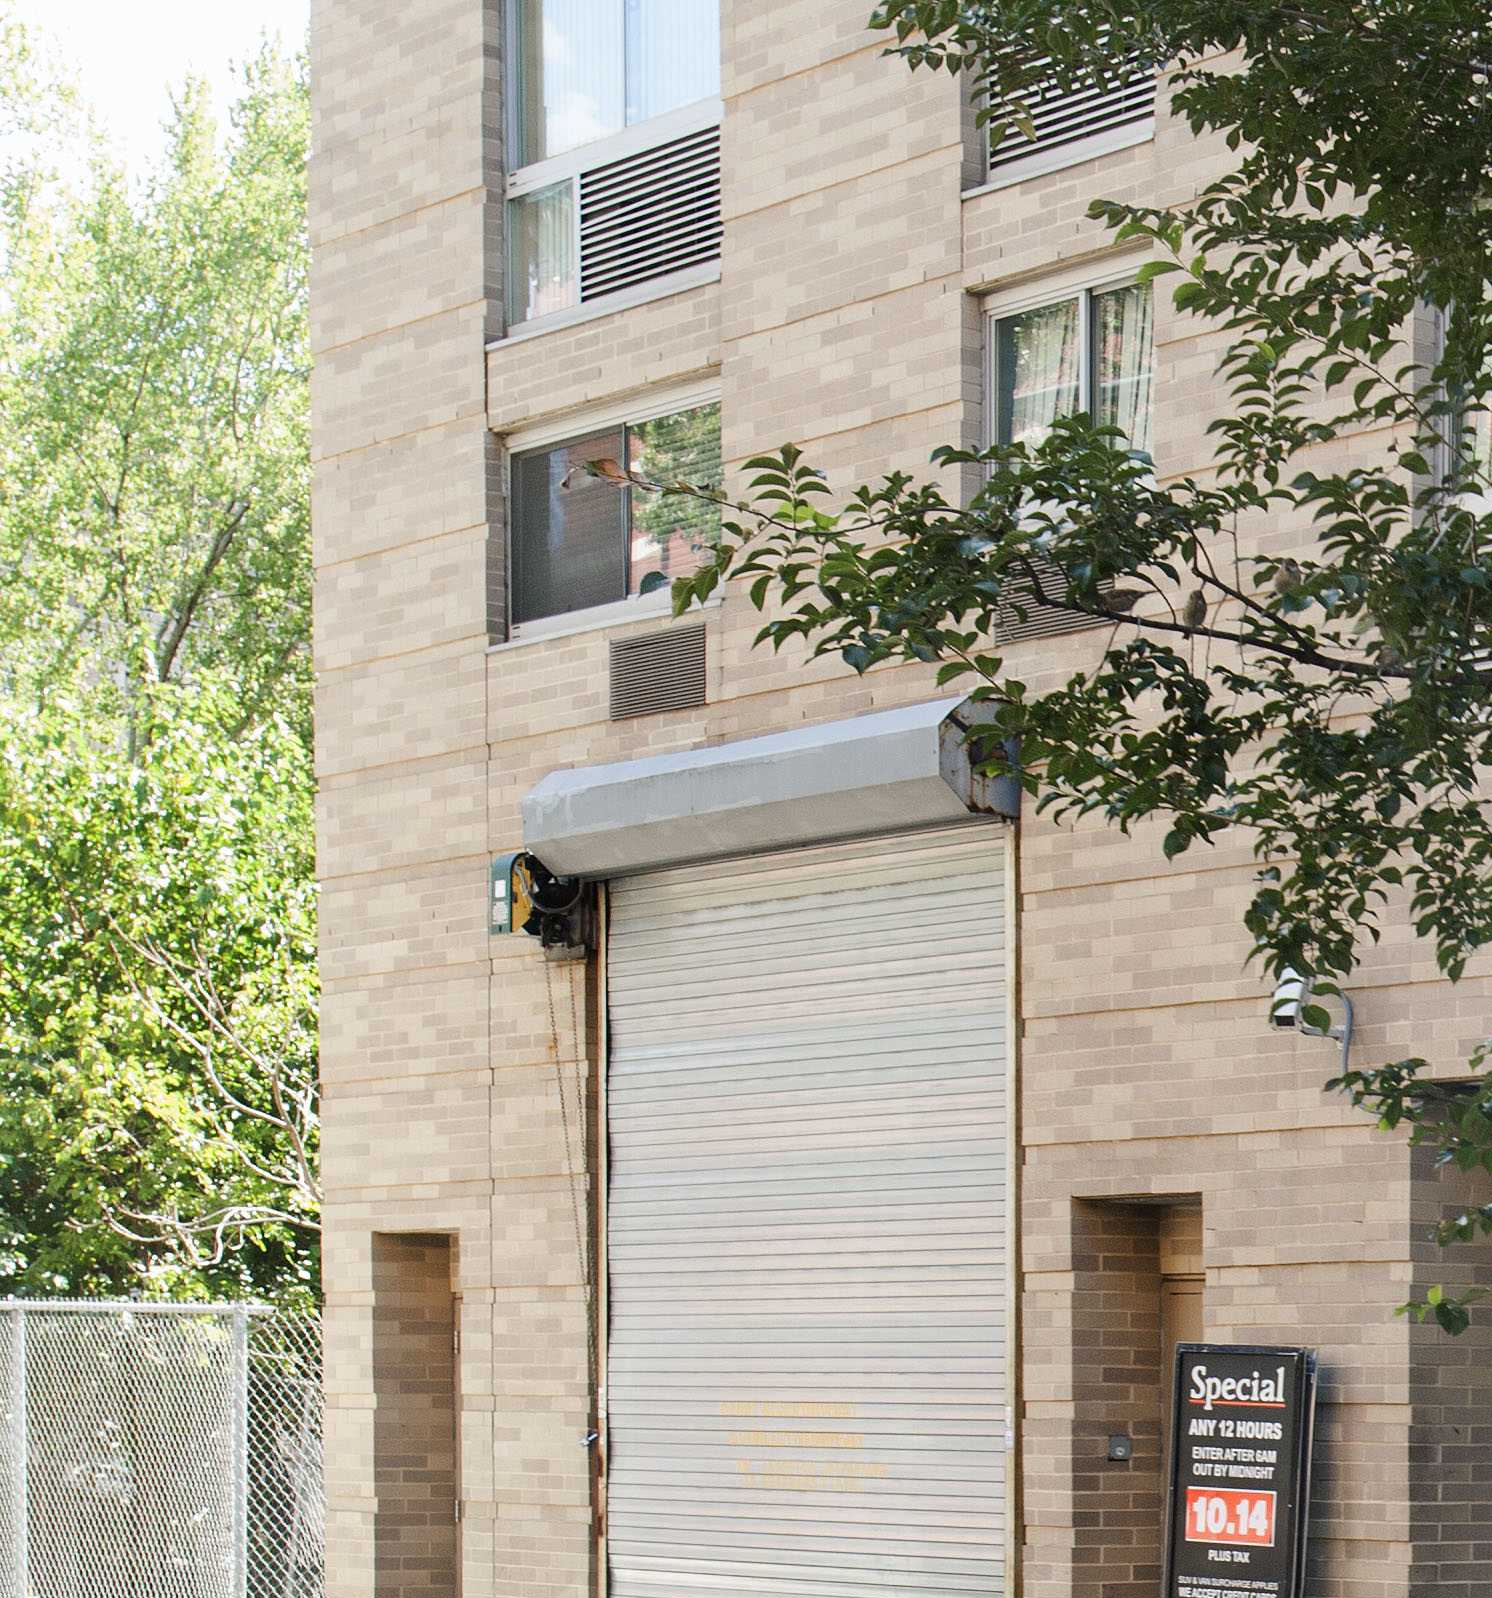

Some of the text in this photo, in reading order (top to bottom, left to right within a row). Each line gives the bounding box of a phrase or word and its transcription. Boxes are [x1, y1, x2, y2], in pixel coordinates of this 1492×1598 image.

[1189, 1365, 1286, 1410] Special
[1188, 1419, 1283, 1440] ANY 12 HOURS
[1192, 1446, 1223, 1460] ENTER
[1224, 1448, 1255, 1462] AFTER
[1193, 1463, 1275, 1479] OUT BY MIDNIGHT
[1192, 1496, 1268, 1537] 10.14
[1207, 1549, 1251, 1563] PLUS TAX
[1178, 1587, 1192, 1597] WE
